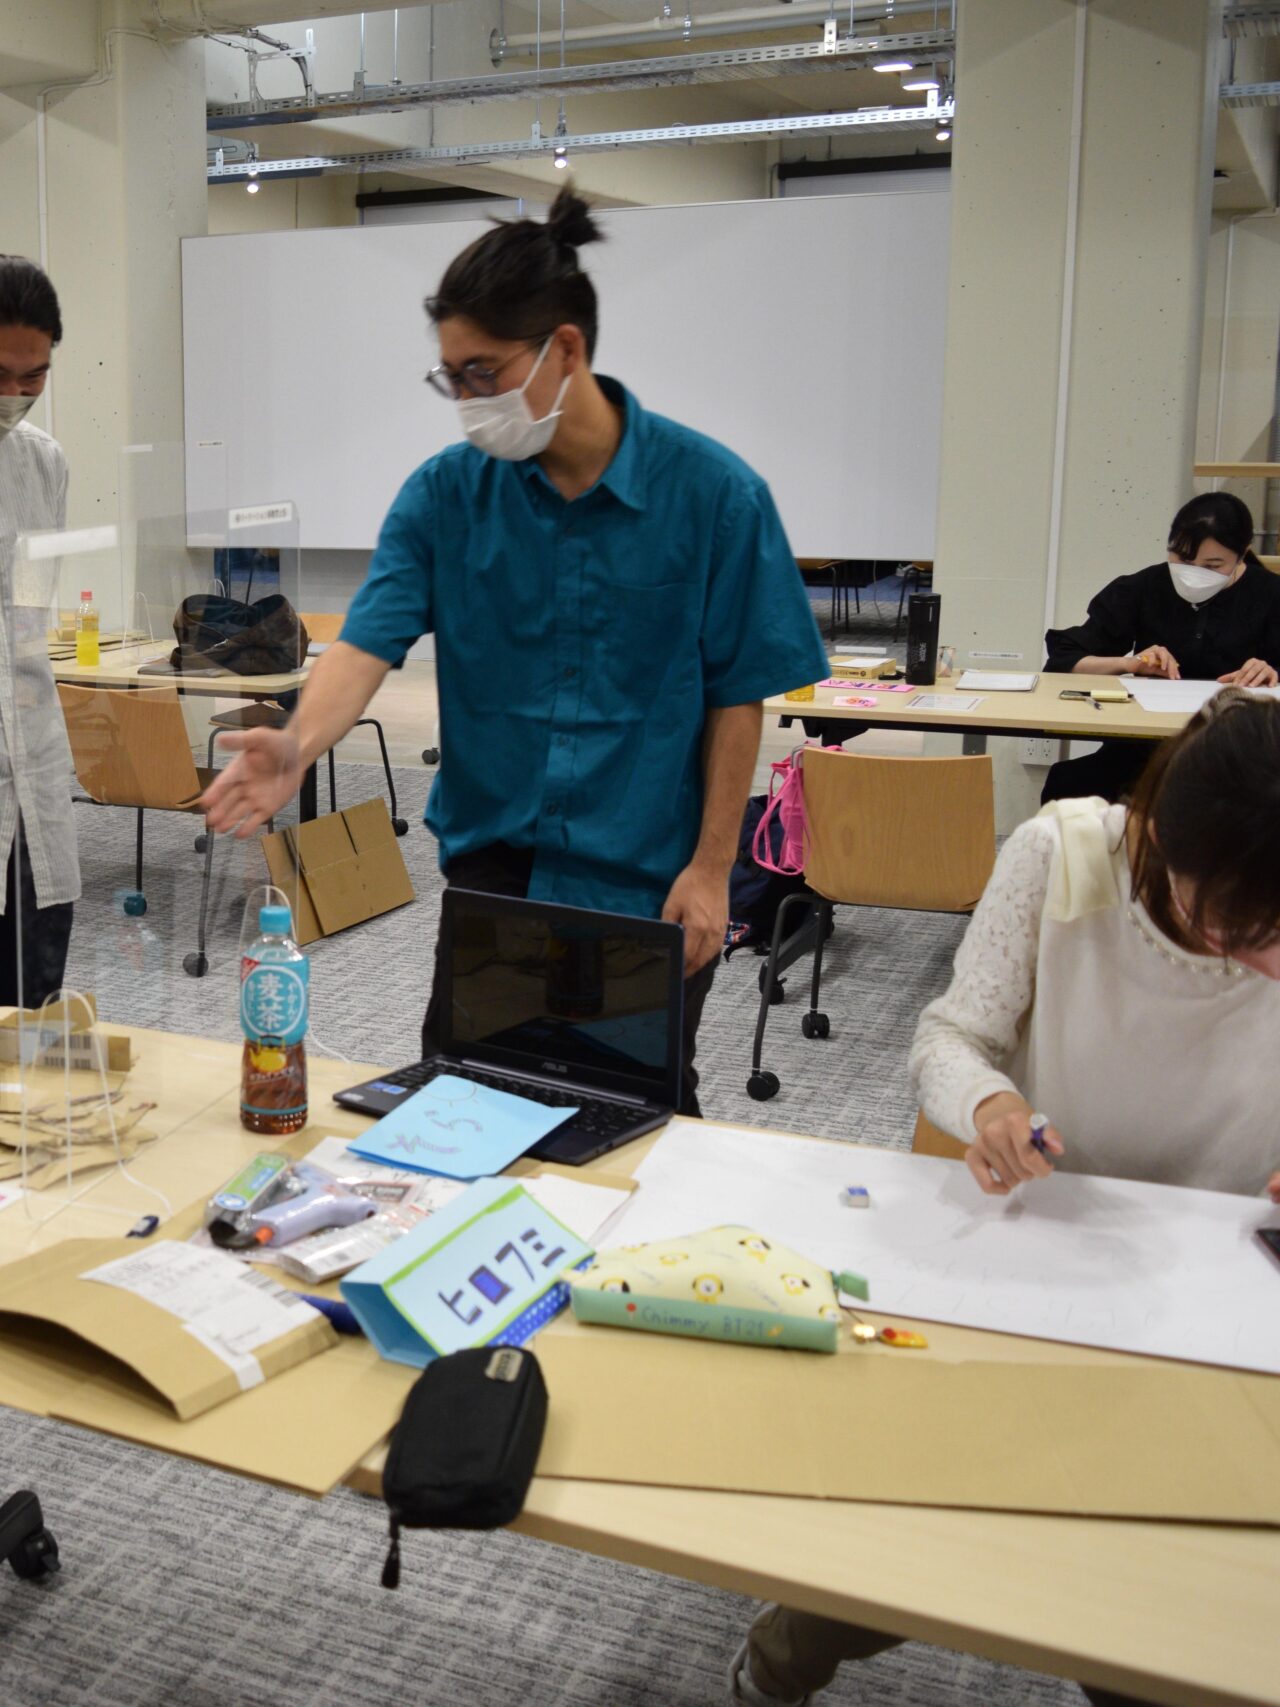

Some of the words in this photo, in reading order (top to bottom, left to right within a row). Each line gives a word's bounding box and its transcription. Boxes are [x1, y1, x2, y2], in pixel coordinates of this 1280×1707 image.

[256, 972, 287, 1031] 麦茶
[437, 1227, 567, 1326] ヒロフミ
[640, 1305, 710, 1334] Chimmy
